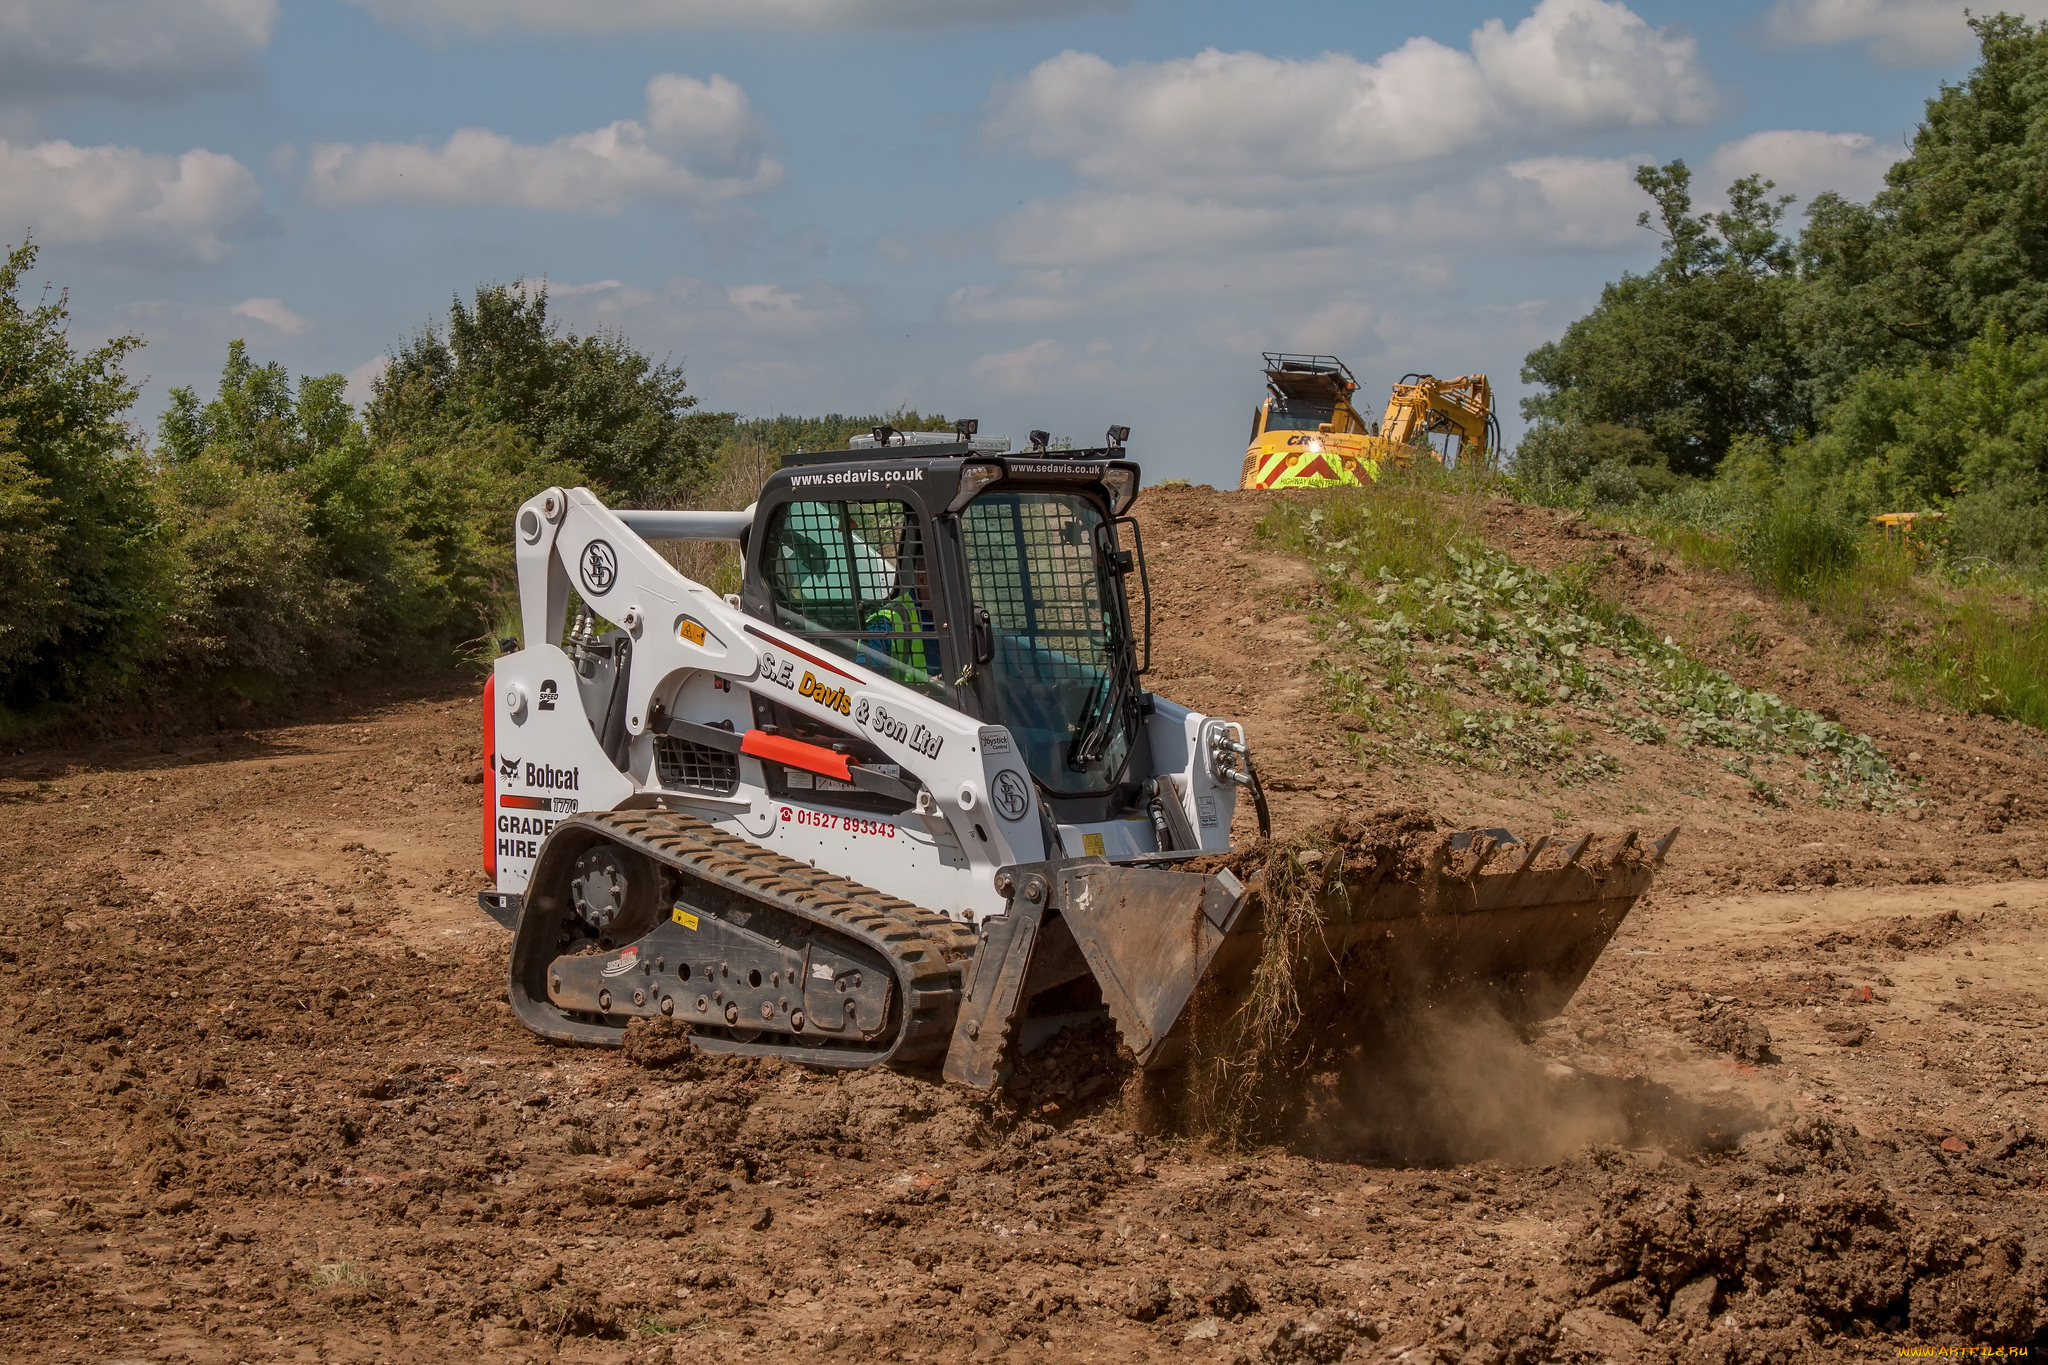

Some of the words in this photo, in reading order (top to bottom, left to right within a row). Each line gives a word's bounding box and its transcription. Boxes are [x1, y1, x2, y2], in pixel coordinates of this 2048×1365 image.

[790, 467, 923, 486] www.sedavis.co.uk
[1010, 463, 1100, 474] www.sedavis.co.uk
[1280, 477, 1307, 486] HIGHWAY
[538, 679, 557, 711] 2
[760, 652, 795, 690] S.E.
[799, 670, 851, 716] Davis
[855, 698, 870, 725] &
[872, 706, 908, 744] Son
[909, 724, 944, 760] Ltd
[983, 735, 1008, 747] Joystick
[526, 762, 579, 791] Bobcat
[553, 797, 579, 813] T770
[498, 815, 560, 836] GRADE
[797, 810, 838, 829] 01527
[843, 817, 895, 838] 893343
[498, 838, 537, 858] HIRE
